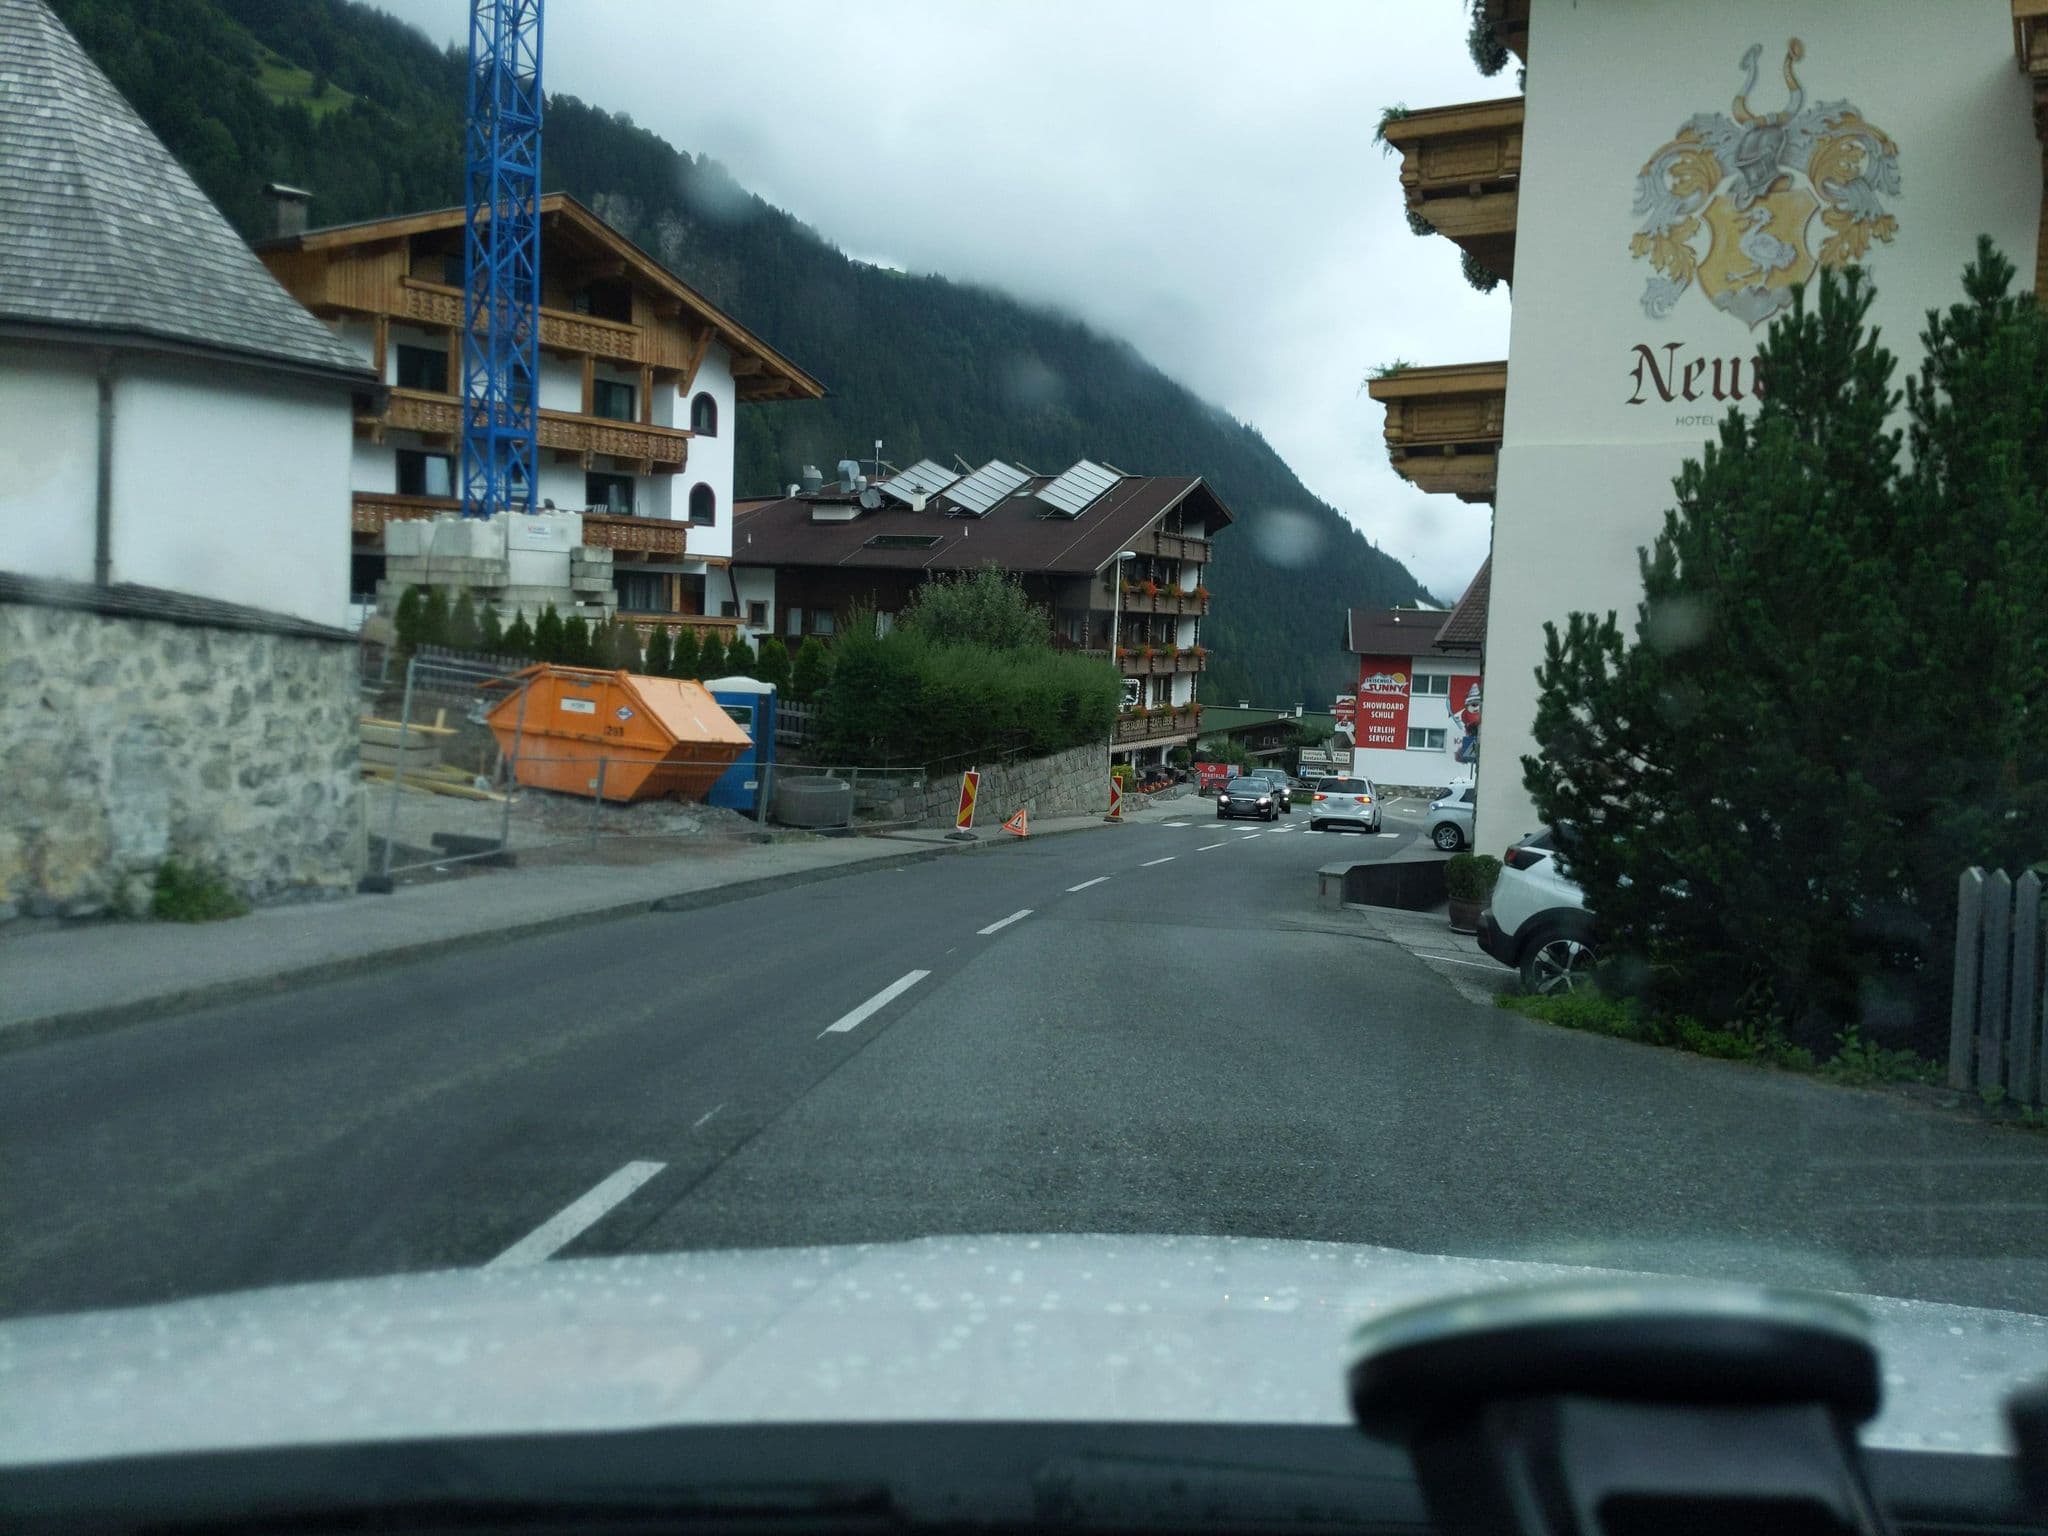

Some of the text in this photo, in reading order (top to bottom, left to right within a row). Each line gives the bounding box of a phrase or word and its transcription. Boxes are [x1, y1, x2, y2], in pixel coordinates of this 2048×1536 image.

[1674, 415, 1716, 427] HOTEL
[1365, 683, 1404, 693] SUNNY
[1362, 701, 1405, 711] SNOWBOARD
[1371, 711, 1395, 720] SCHULE
[1368, 725, 1396, 734] VERLEIH
[1368, 735, 1395, 743] SERVICE
